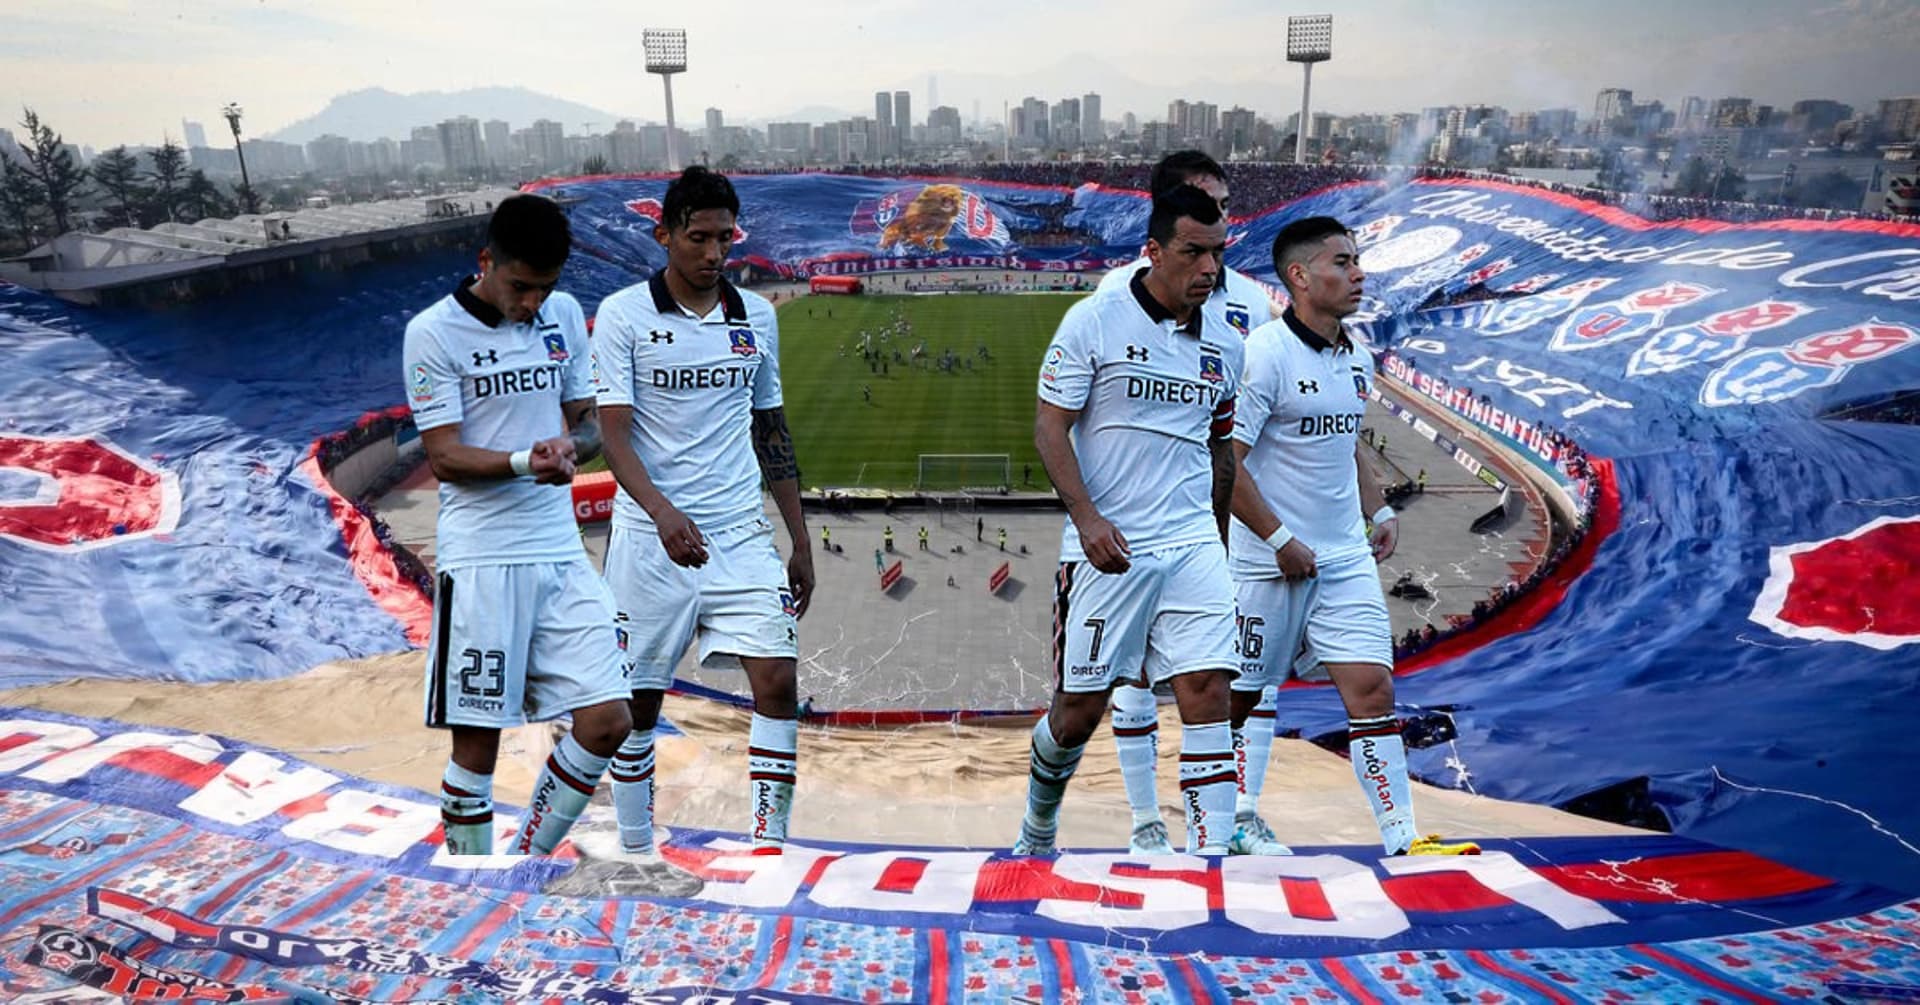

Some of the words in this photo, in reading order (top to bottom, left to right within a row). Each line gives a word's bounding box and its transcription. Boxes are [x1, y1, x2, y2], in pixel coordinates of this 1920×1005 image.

[1387, 355, 1415, 387] SON
[1419, 376, 1554, 461] SENTIMIENTOS
[460, 648, 506, 697] 23
[1083, 618, 1106, 662] 7
[1035, 851, 1628, 940] LOS
